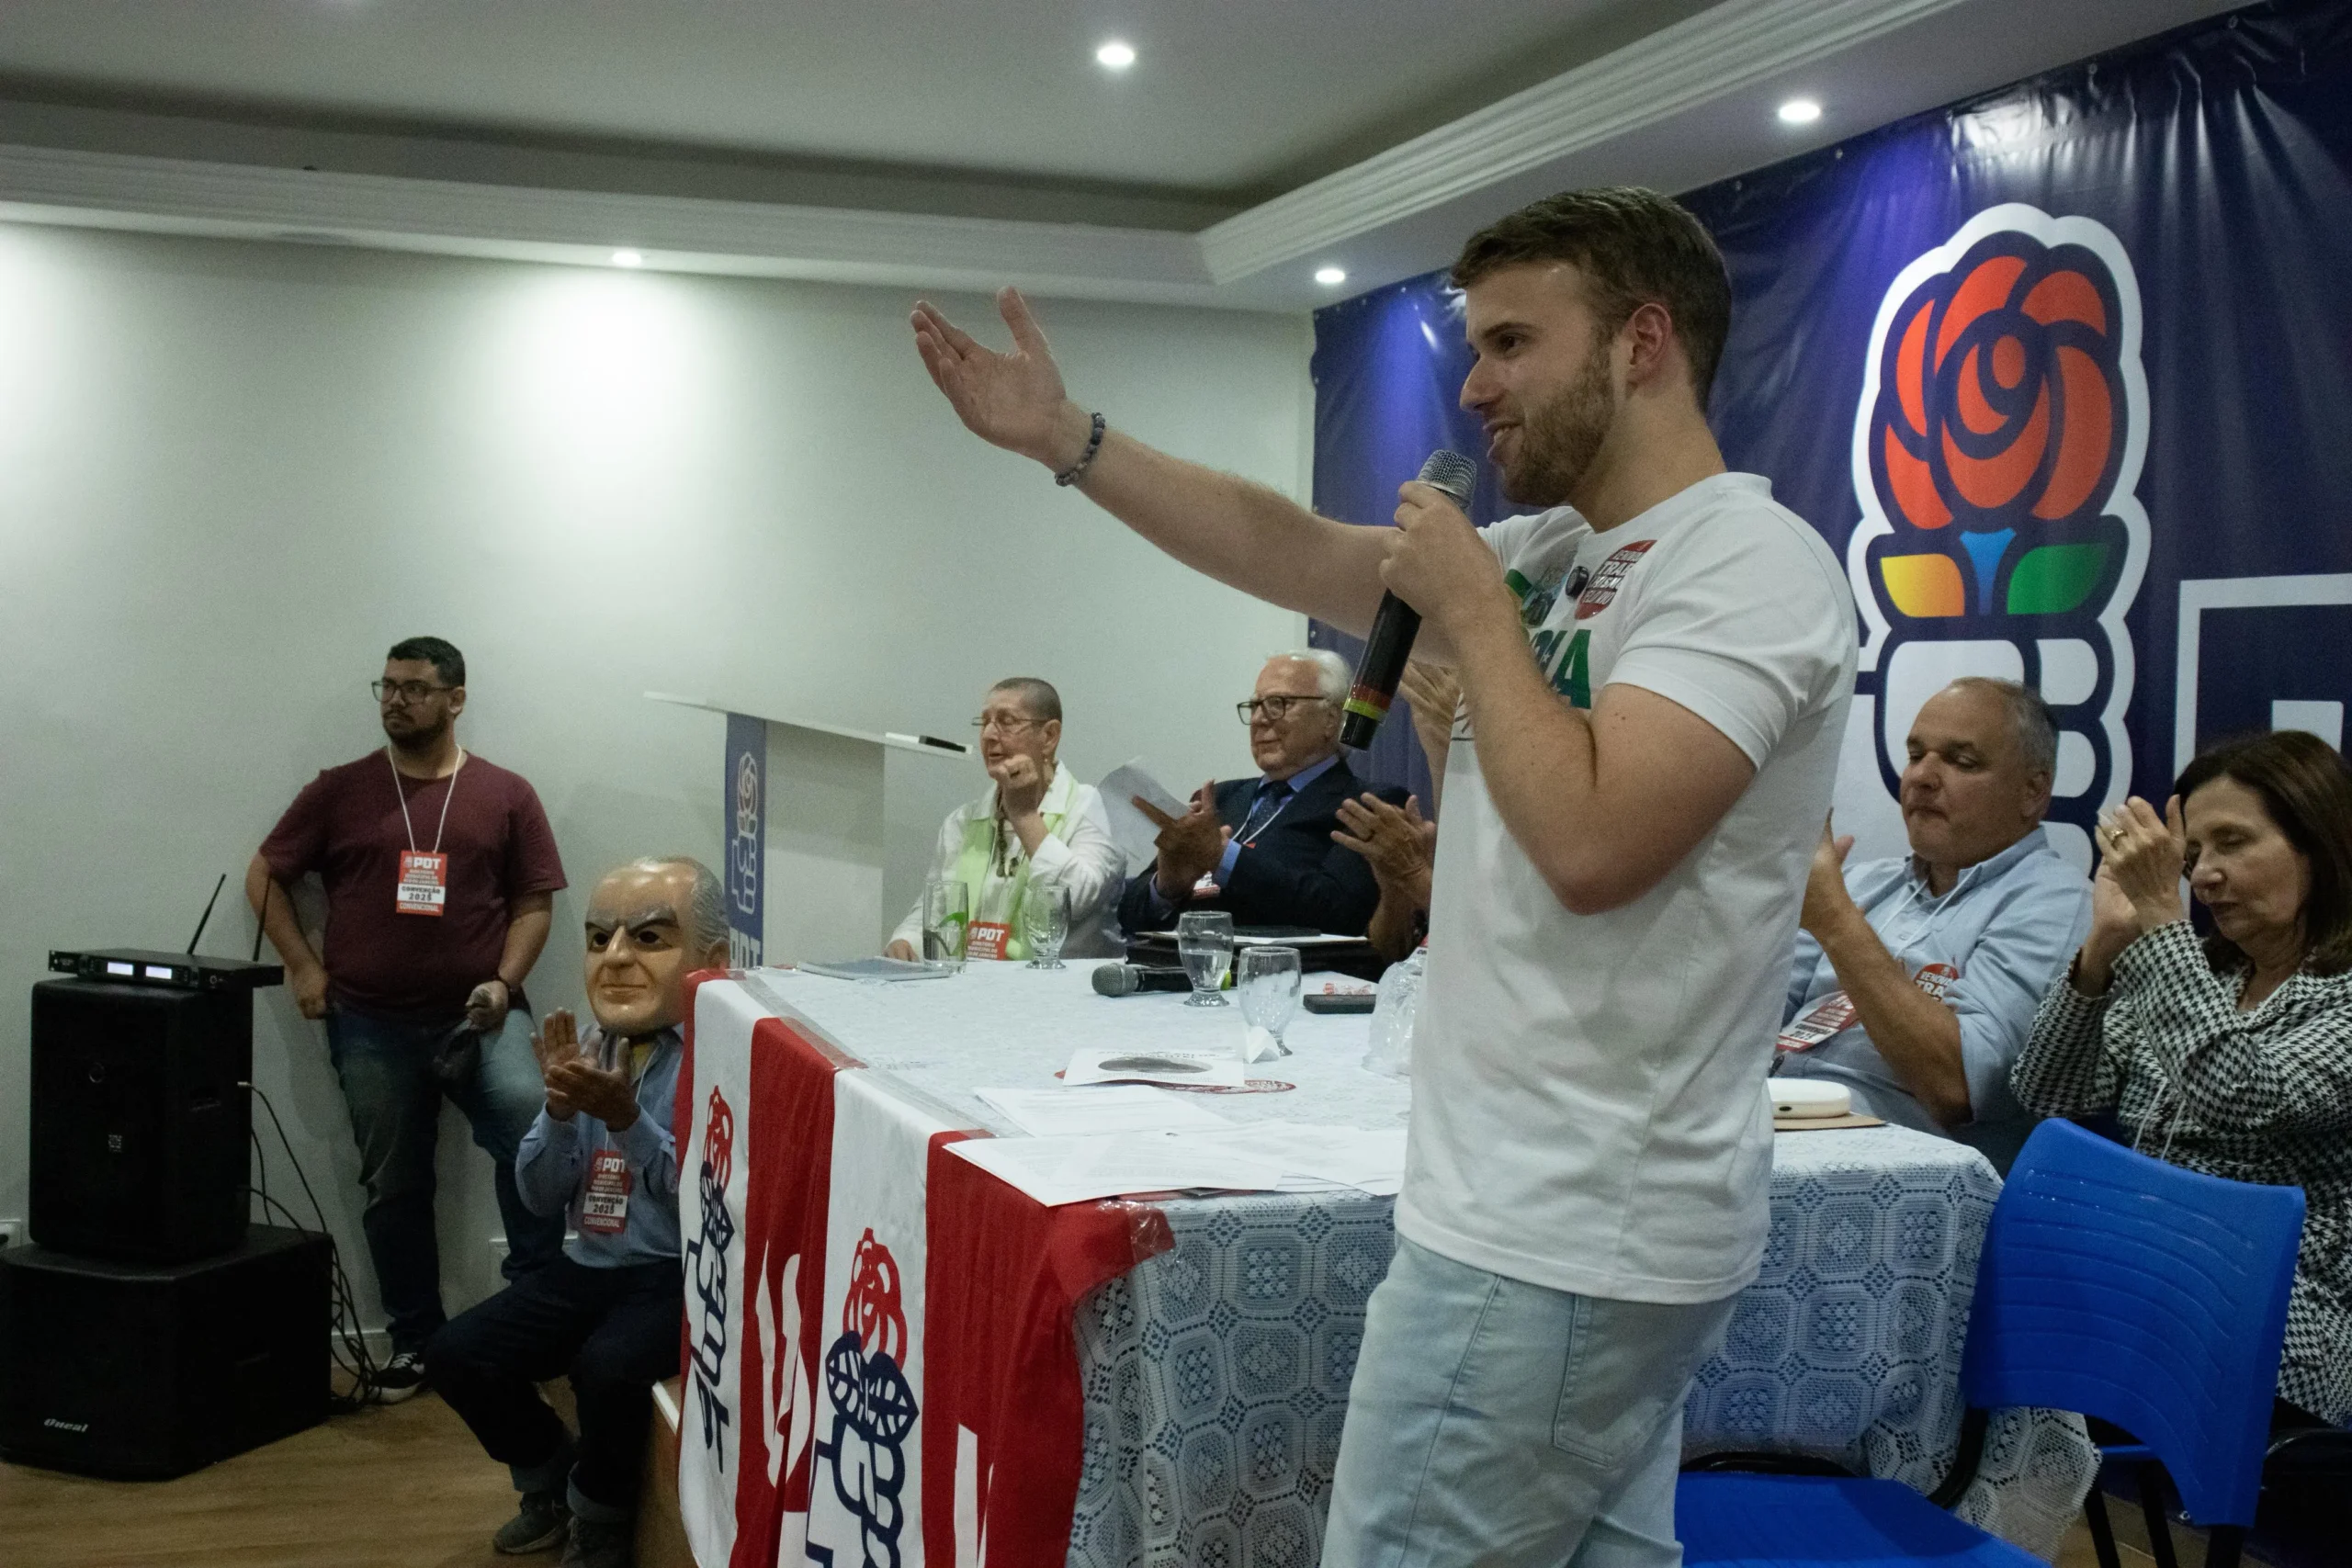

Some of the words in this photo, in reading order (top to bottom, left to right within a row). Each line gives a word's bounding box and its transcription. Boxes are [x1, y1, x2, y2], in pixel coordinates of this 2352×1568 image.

[413, 856, 441, 869] PDT
[977, 927, 1005, 942] PDT
[589, 1193, 624, 1206] CONVENÇÃO
[594, 1203, 616, 1215] 2025
[43, 1418, 89, 1433] Oneal
